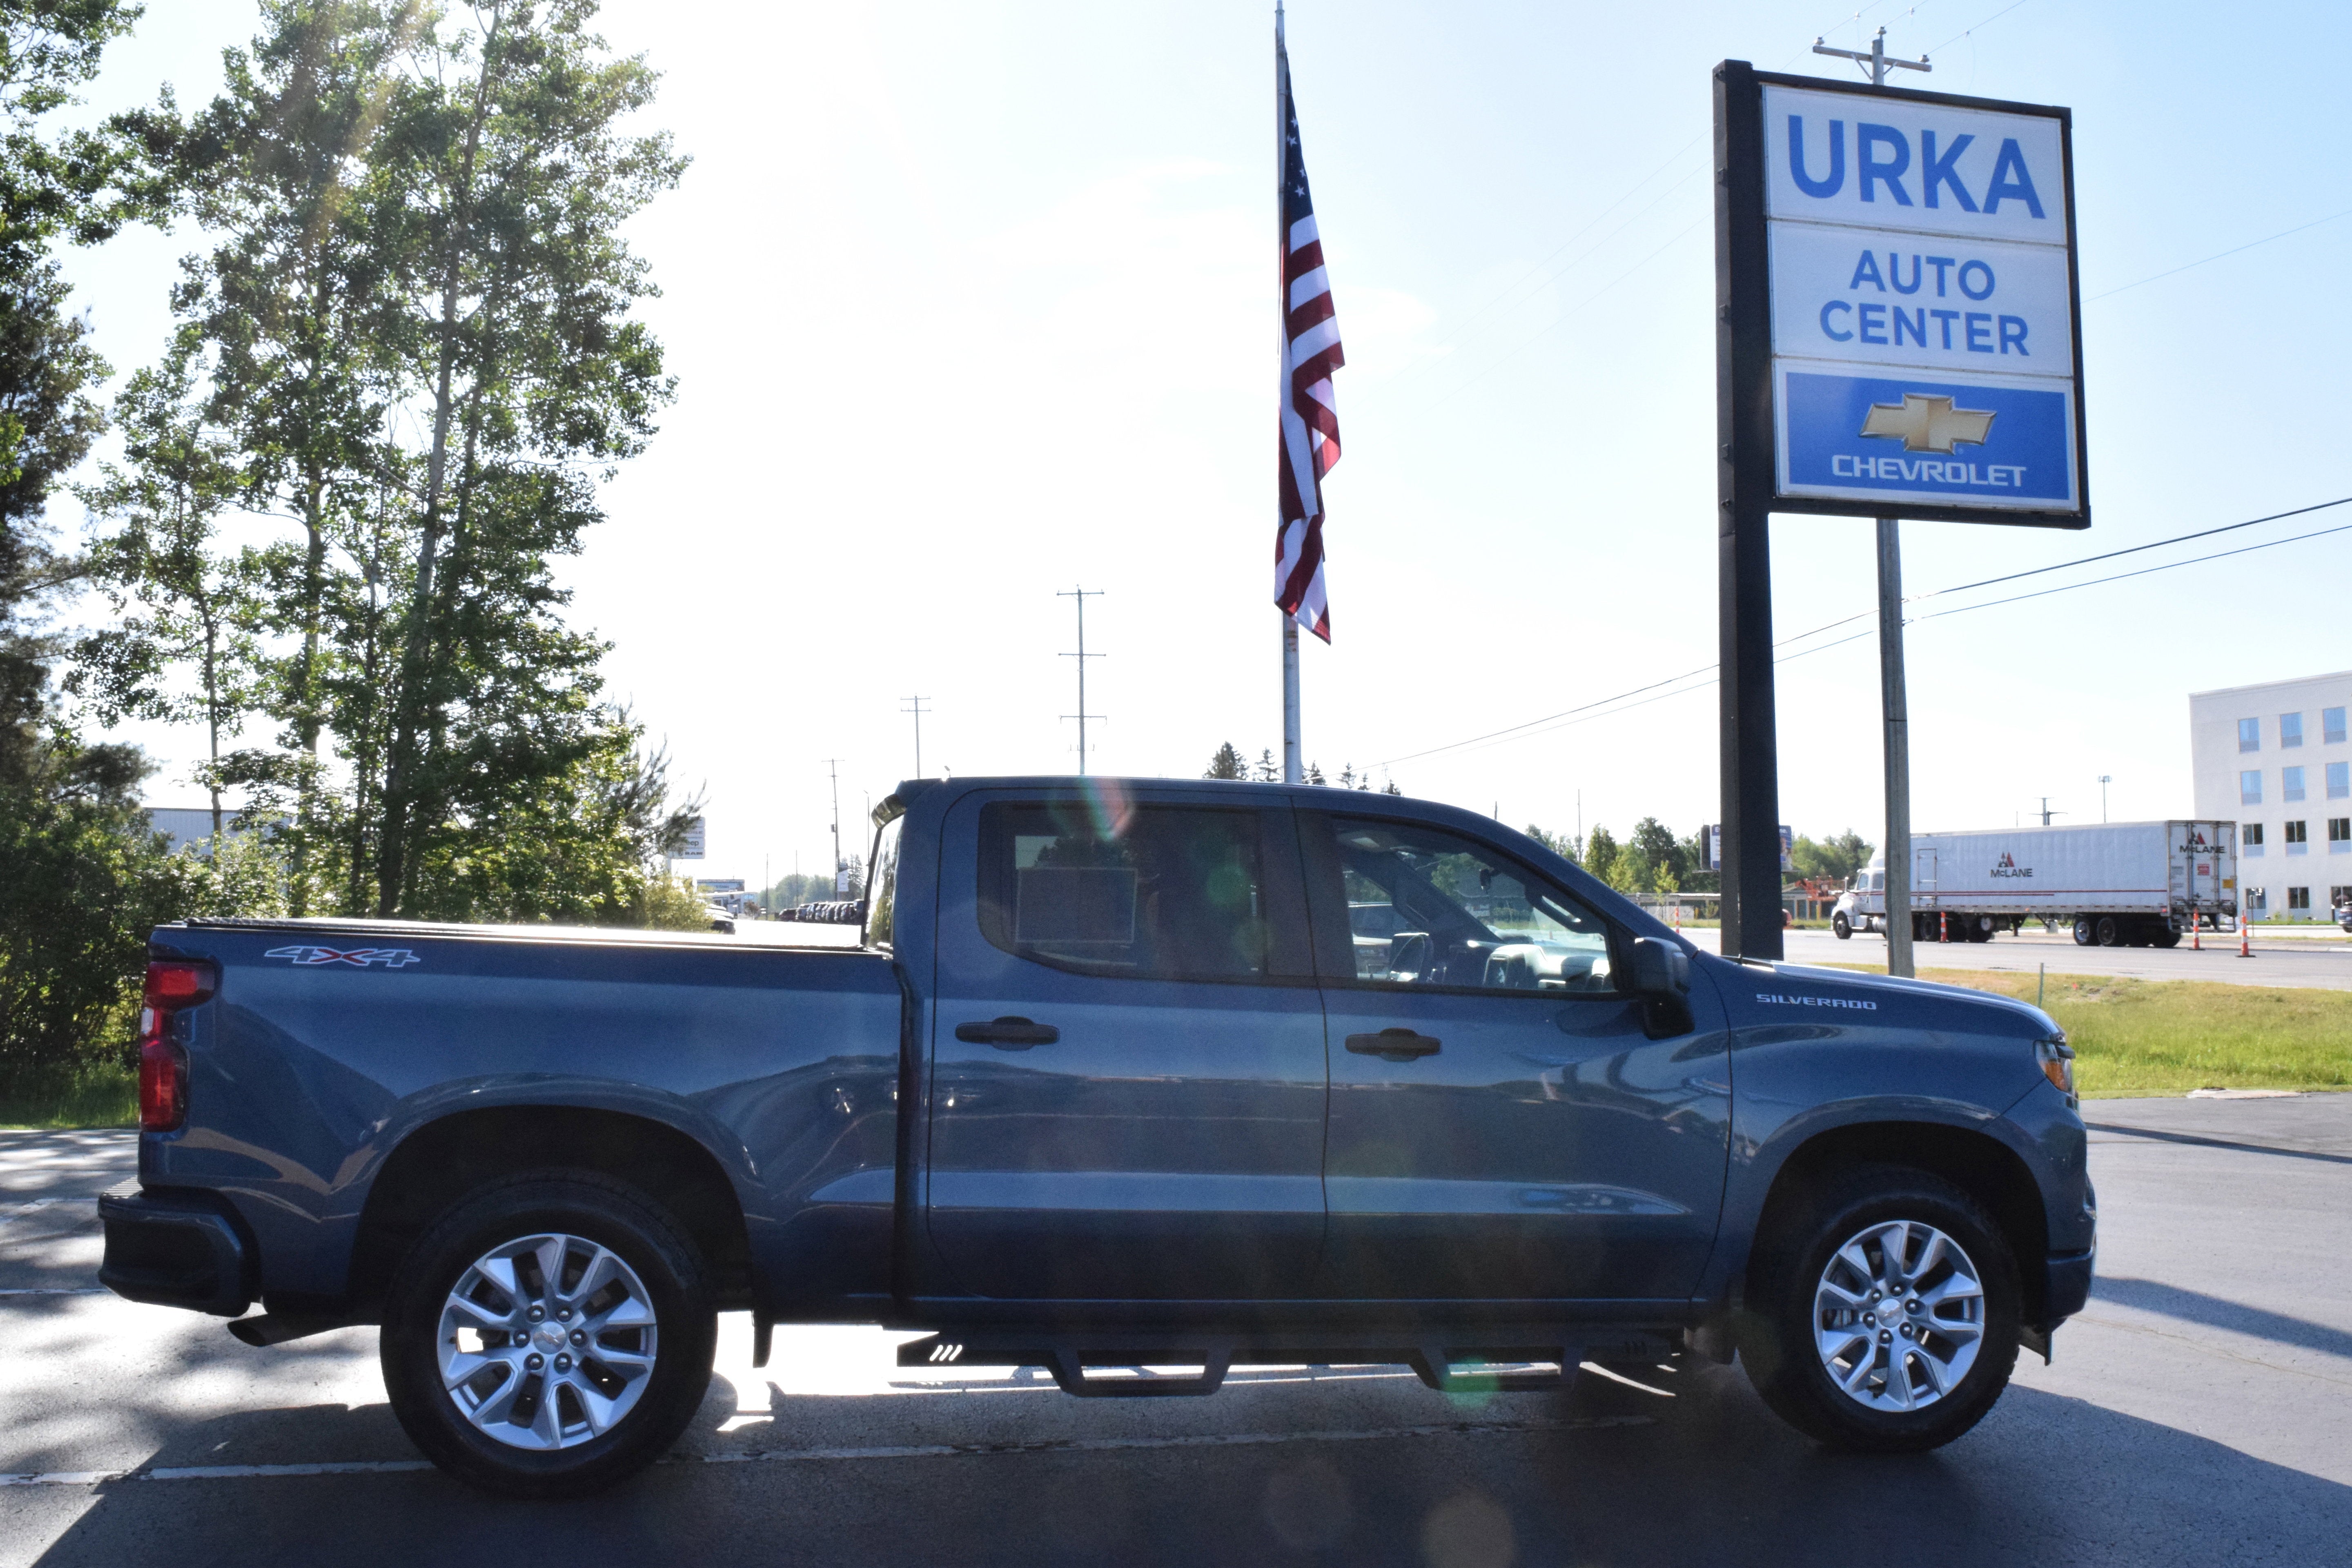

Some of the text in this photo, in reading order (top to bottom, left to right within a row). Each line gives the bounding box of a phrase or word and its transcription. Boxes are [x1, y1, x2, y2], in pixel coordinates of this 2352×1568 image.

[1788, 115, 2046, 219] URKA
[1850, 250, 1995, 301] AUTO
[1820, 300, 2029, 356] CENTER
[1832, 455, 2027, 487] CHEVROLET
[1990, 868, 2033, 878] McLANE
[1756, 994, 1877, 1010] SILVERADO
